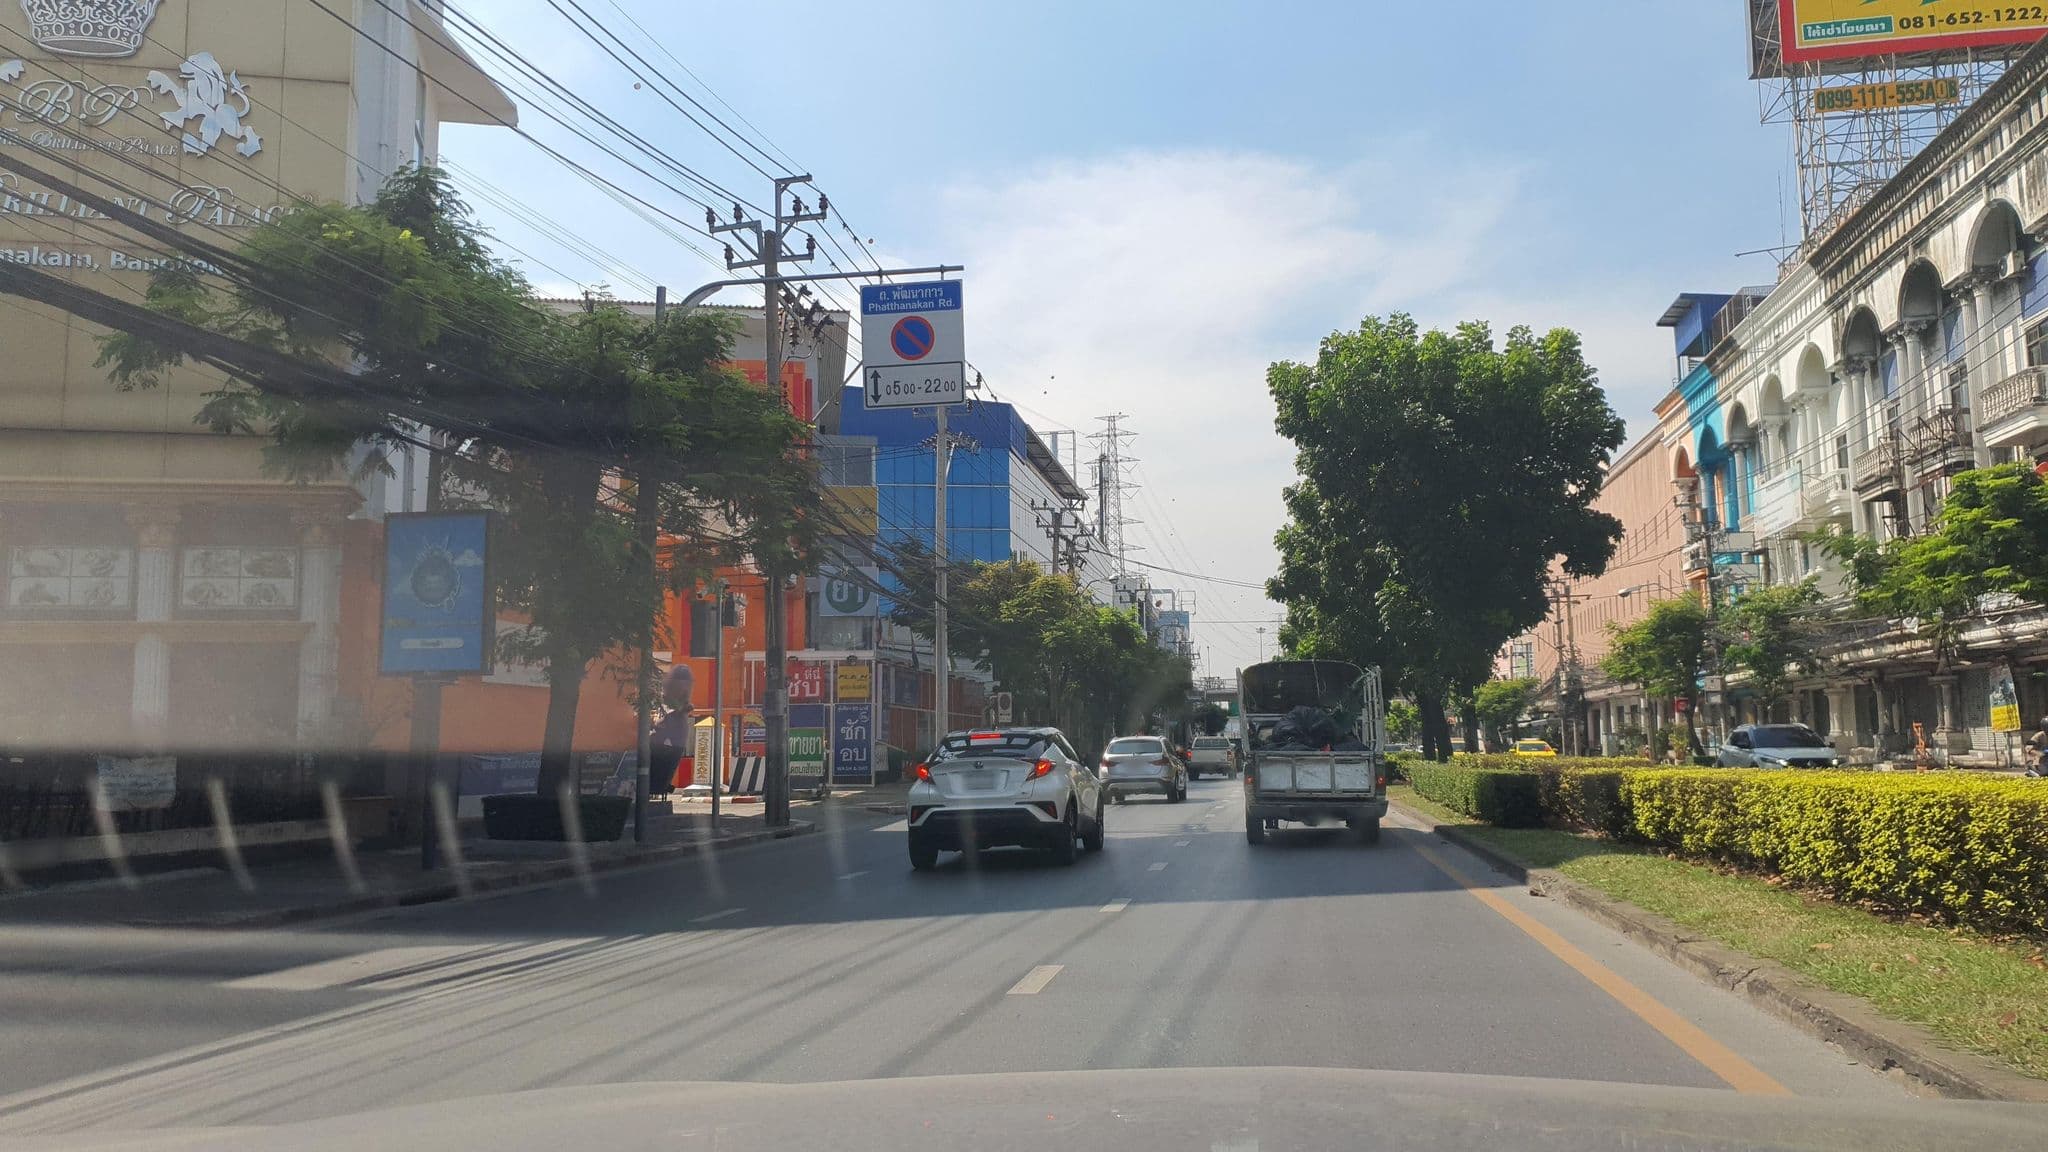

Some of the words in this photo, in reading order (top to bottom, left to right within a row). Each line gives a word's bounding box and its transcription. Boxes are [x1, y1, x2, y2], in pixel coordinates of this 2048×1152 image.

[892, 286, 944, 300] พัฒนาการ
[868, 300, 935, 312] Phatthanakan
[938, 298, 955, 307] Rd.
[789, 736, 822, 755] ขายยา
[840, 747, 867, 762] อบ
